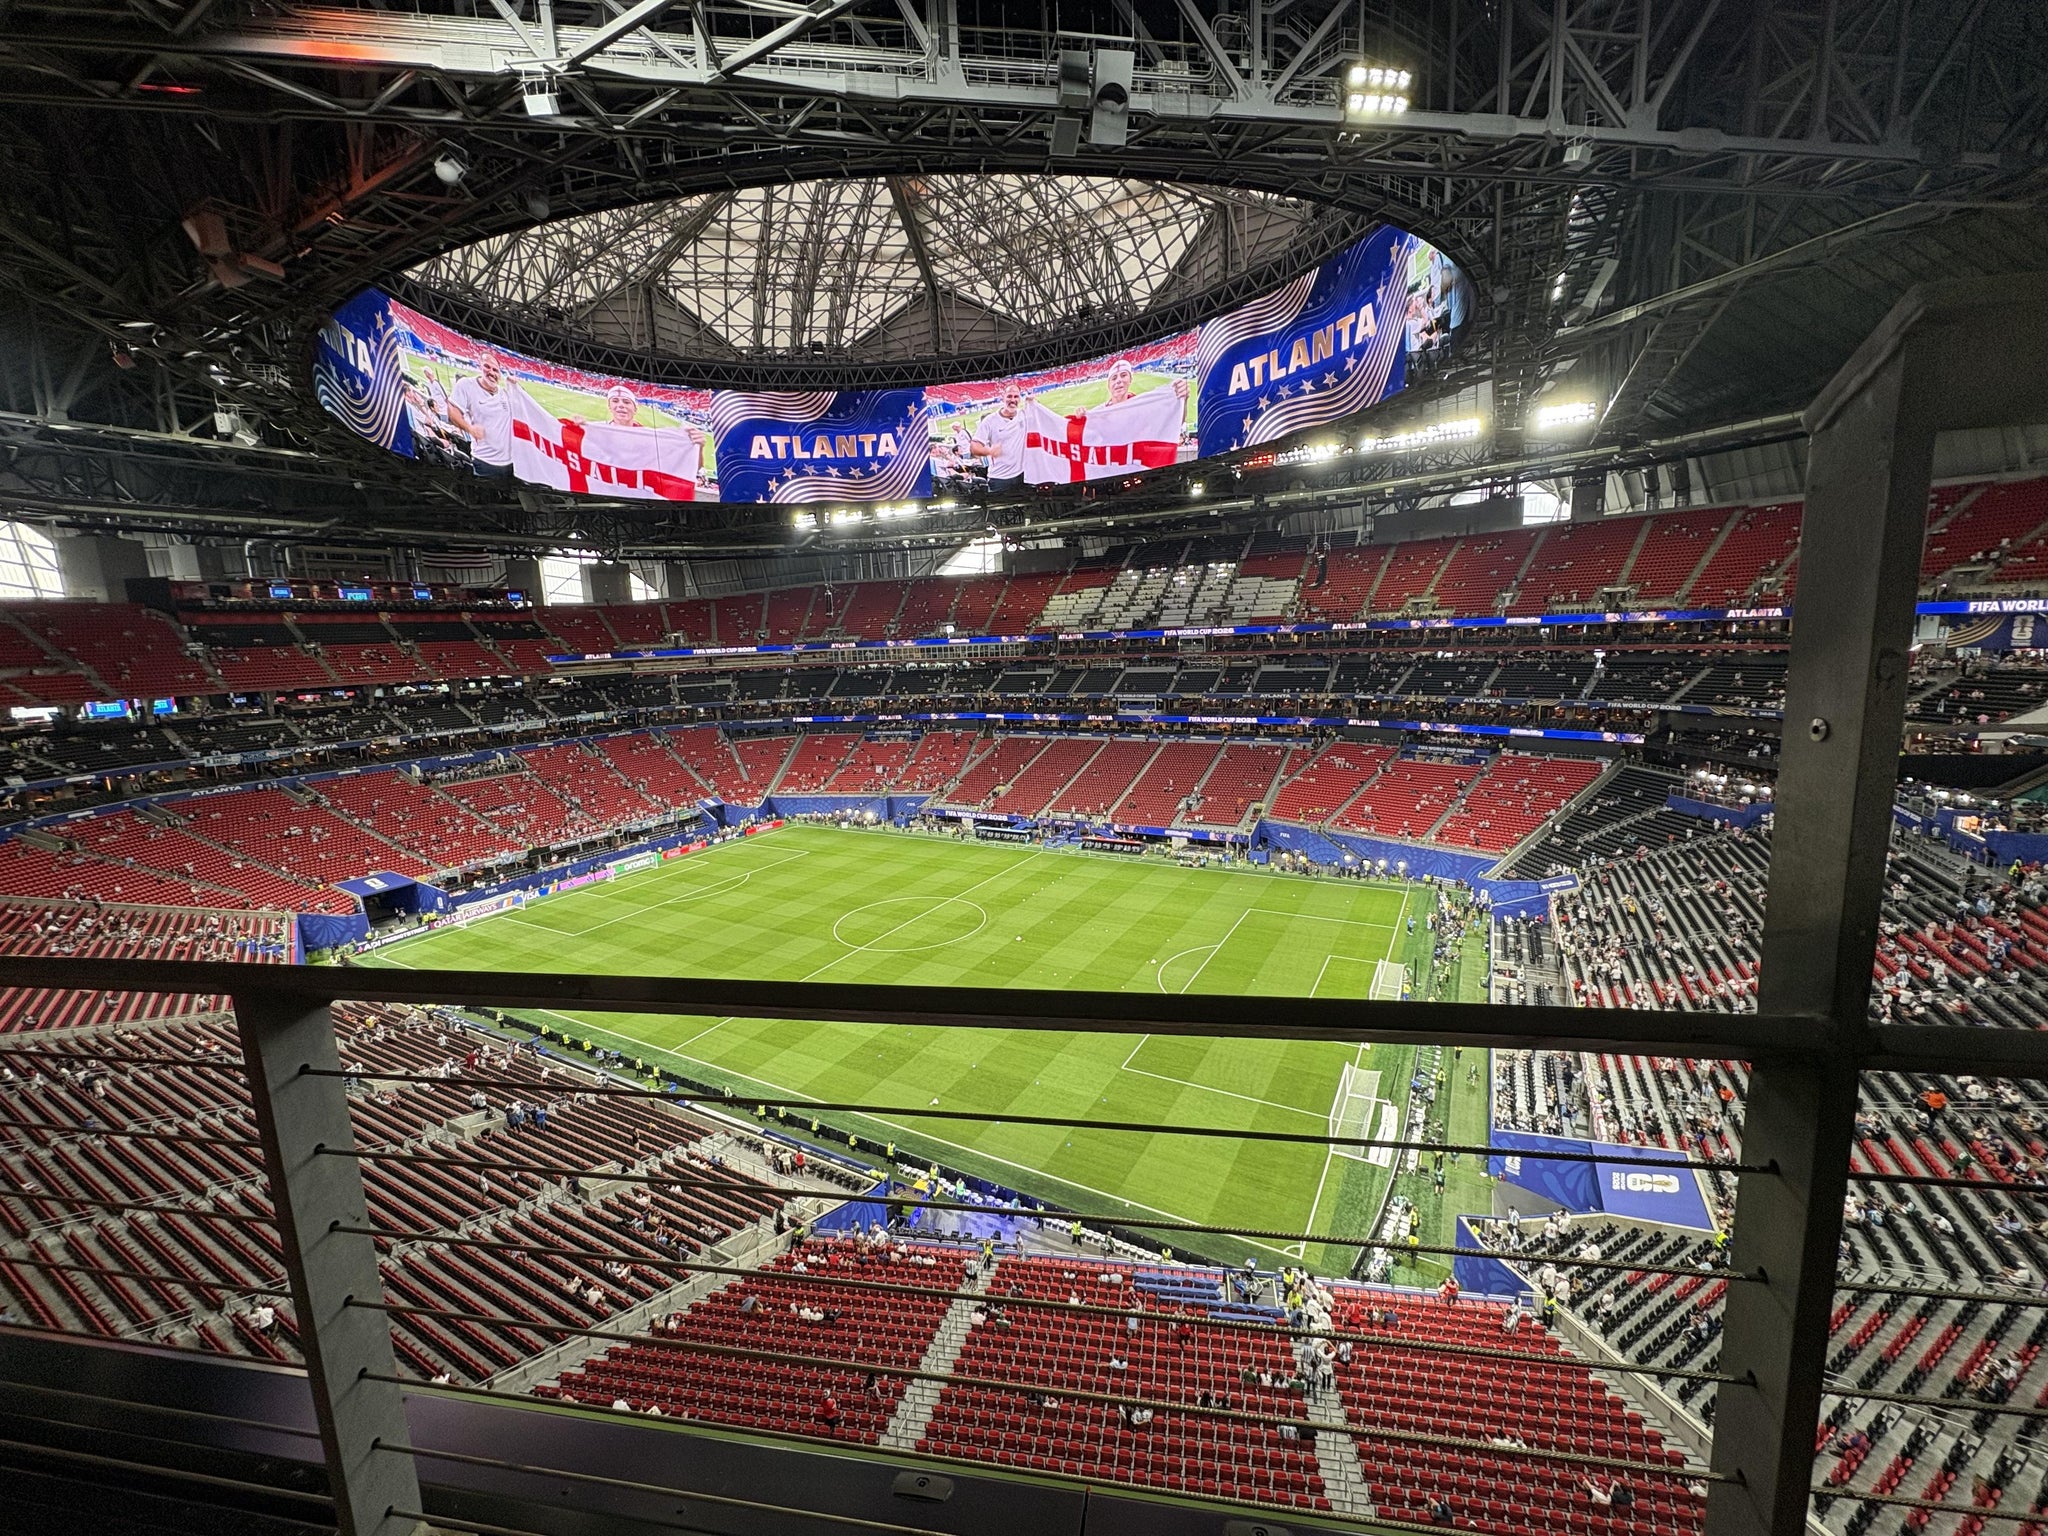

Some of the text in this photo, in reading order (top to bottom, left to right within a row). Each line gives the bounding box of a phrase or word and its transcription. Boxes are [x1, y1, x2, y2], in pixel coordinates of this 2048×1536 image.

[1228, 303, 1377, 396] ATLANTA
[750, 433, 899, 459] ATLANTA
[1968, 601, 2000, 612] FIFA
[1726, 608, 1783, 618] ATLANTA
[1332, 622, 1367, 630] ATLANTA
[1348, 719, 1380, 727] ATLANTA
[294, 743, 338, 753] ATLANTA
[439, 753, 474, 762] ATLANTA
[191, 785, 242, 797] ATLANTA
[549, 843, 562, 851] FIFA
[562, 837, 581, 848] WORLD
[581, 834, 592, 843] CUP
[485, 887, 498, 896] FIFA
[523, 889, 541, 901] VISA
[433, 911, 462, 928] QATAR
[463, 902, 498, 919] AIRWAYS
[363, 939, 381, 951] ADI
